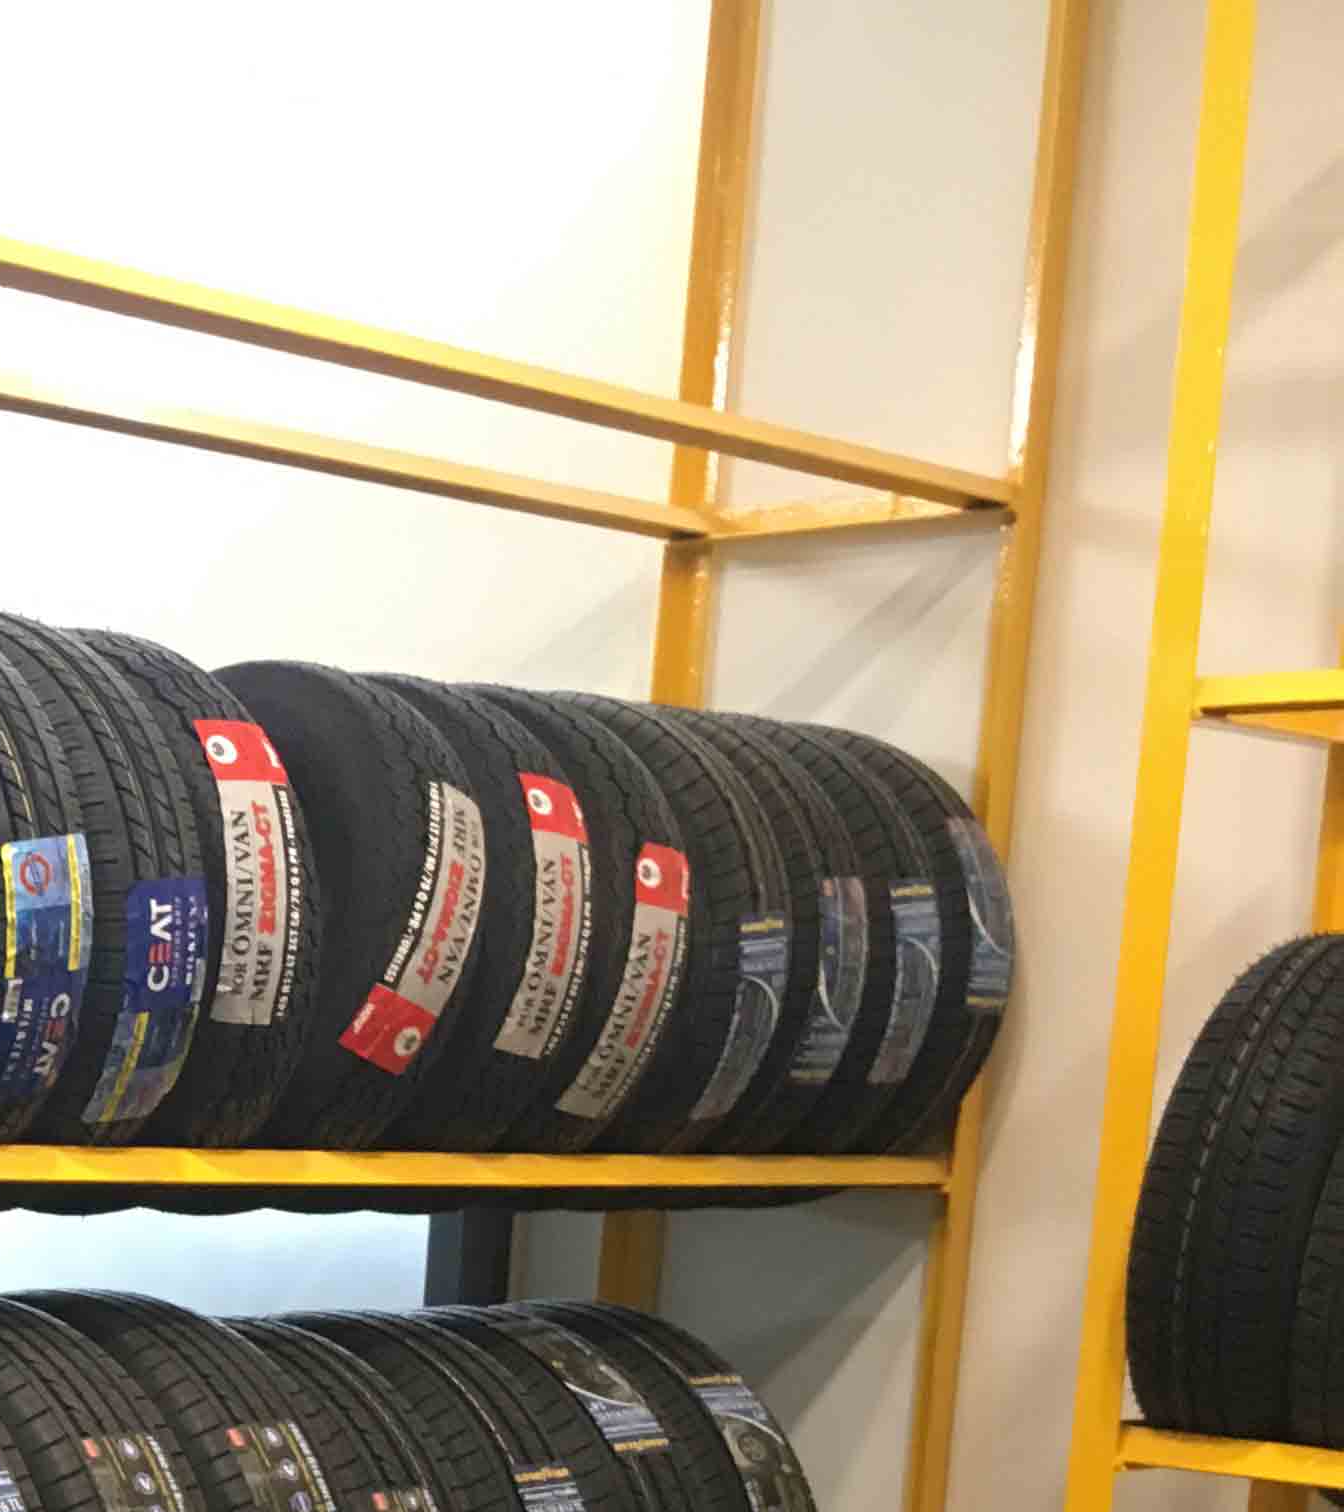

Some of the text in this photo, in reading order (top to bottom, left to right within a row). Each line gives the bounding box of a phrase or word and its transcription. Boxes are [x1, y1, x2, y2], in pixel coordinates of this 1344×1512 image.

[148, 898, 172, 991] CEAT
[231, 811, 251, 956] OMNI/VAN
[525, 859, 556, 992] OMNI/VAN
[252, 943, 273, 1000] MRF
[595, 933, 651, 1059] OMNI/VAN
